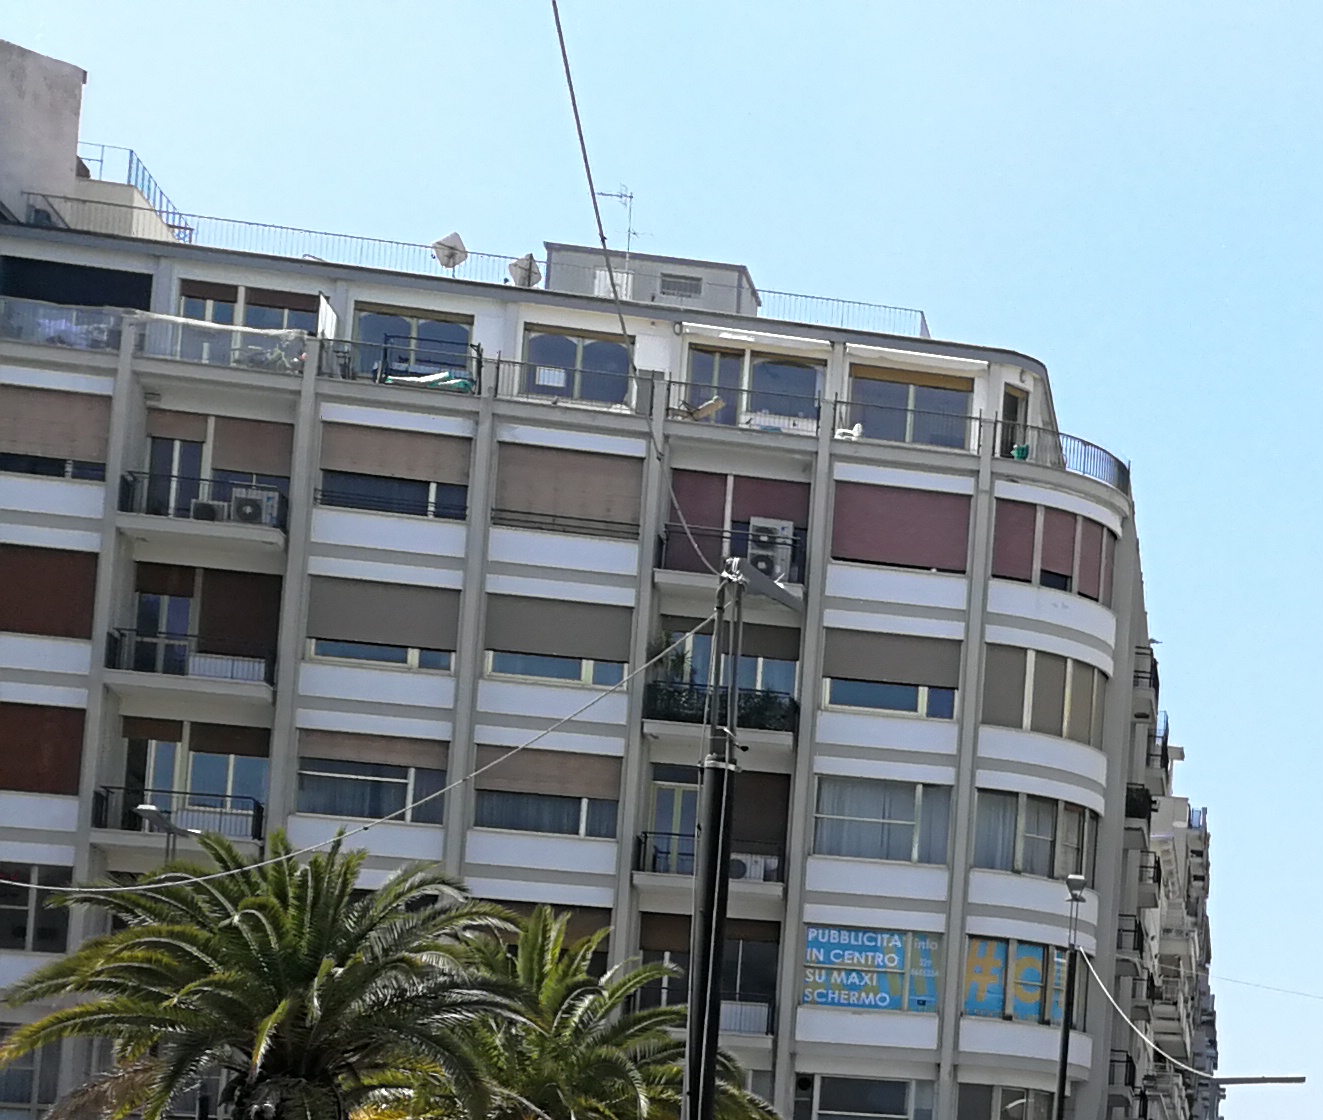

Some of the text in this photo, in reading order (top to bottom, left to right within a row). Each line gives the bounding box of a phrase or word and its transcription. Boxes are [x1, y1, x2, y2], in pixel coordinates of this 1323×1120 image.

[806, 947, 899, 967] IN CENTRO
[804, 969, 877, 986] SU MAXI
[803, 988, 890, 1007] SCHERMO
